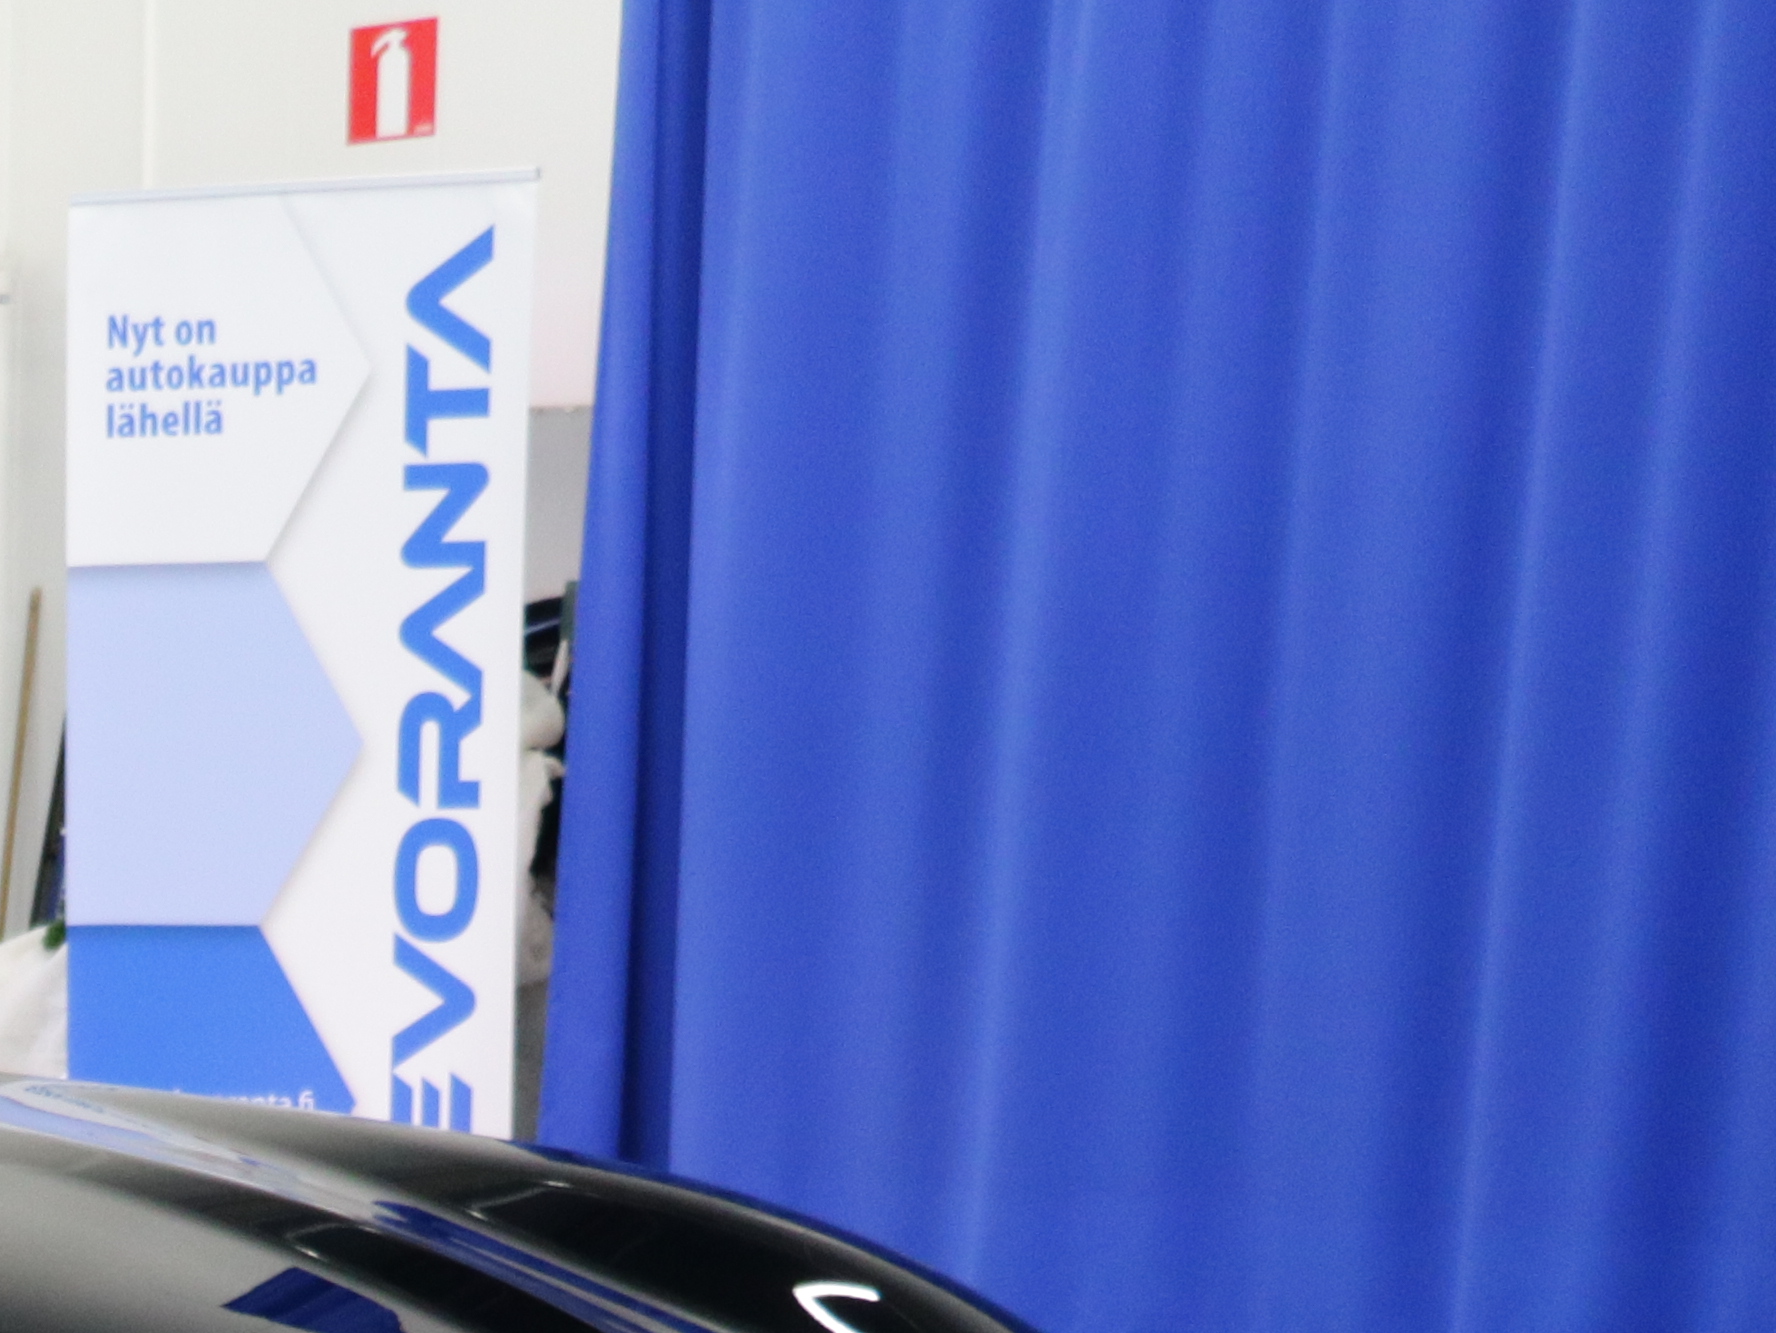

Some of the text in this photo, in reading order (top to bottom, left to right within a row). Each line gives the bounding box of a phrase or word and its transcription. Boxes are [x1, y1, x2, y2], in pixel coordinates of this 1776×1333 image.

[107, 314, 217, 357] Nyt on
[106, 353, 317, 396] autokauppa
[106, 400, 224, 439] lähellä
